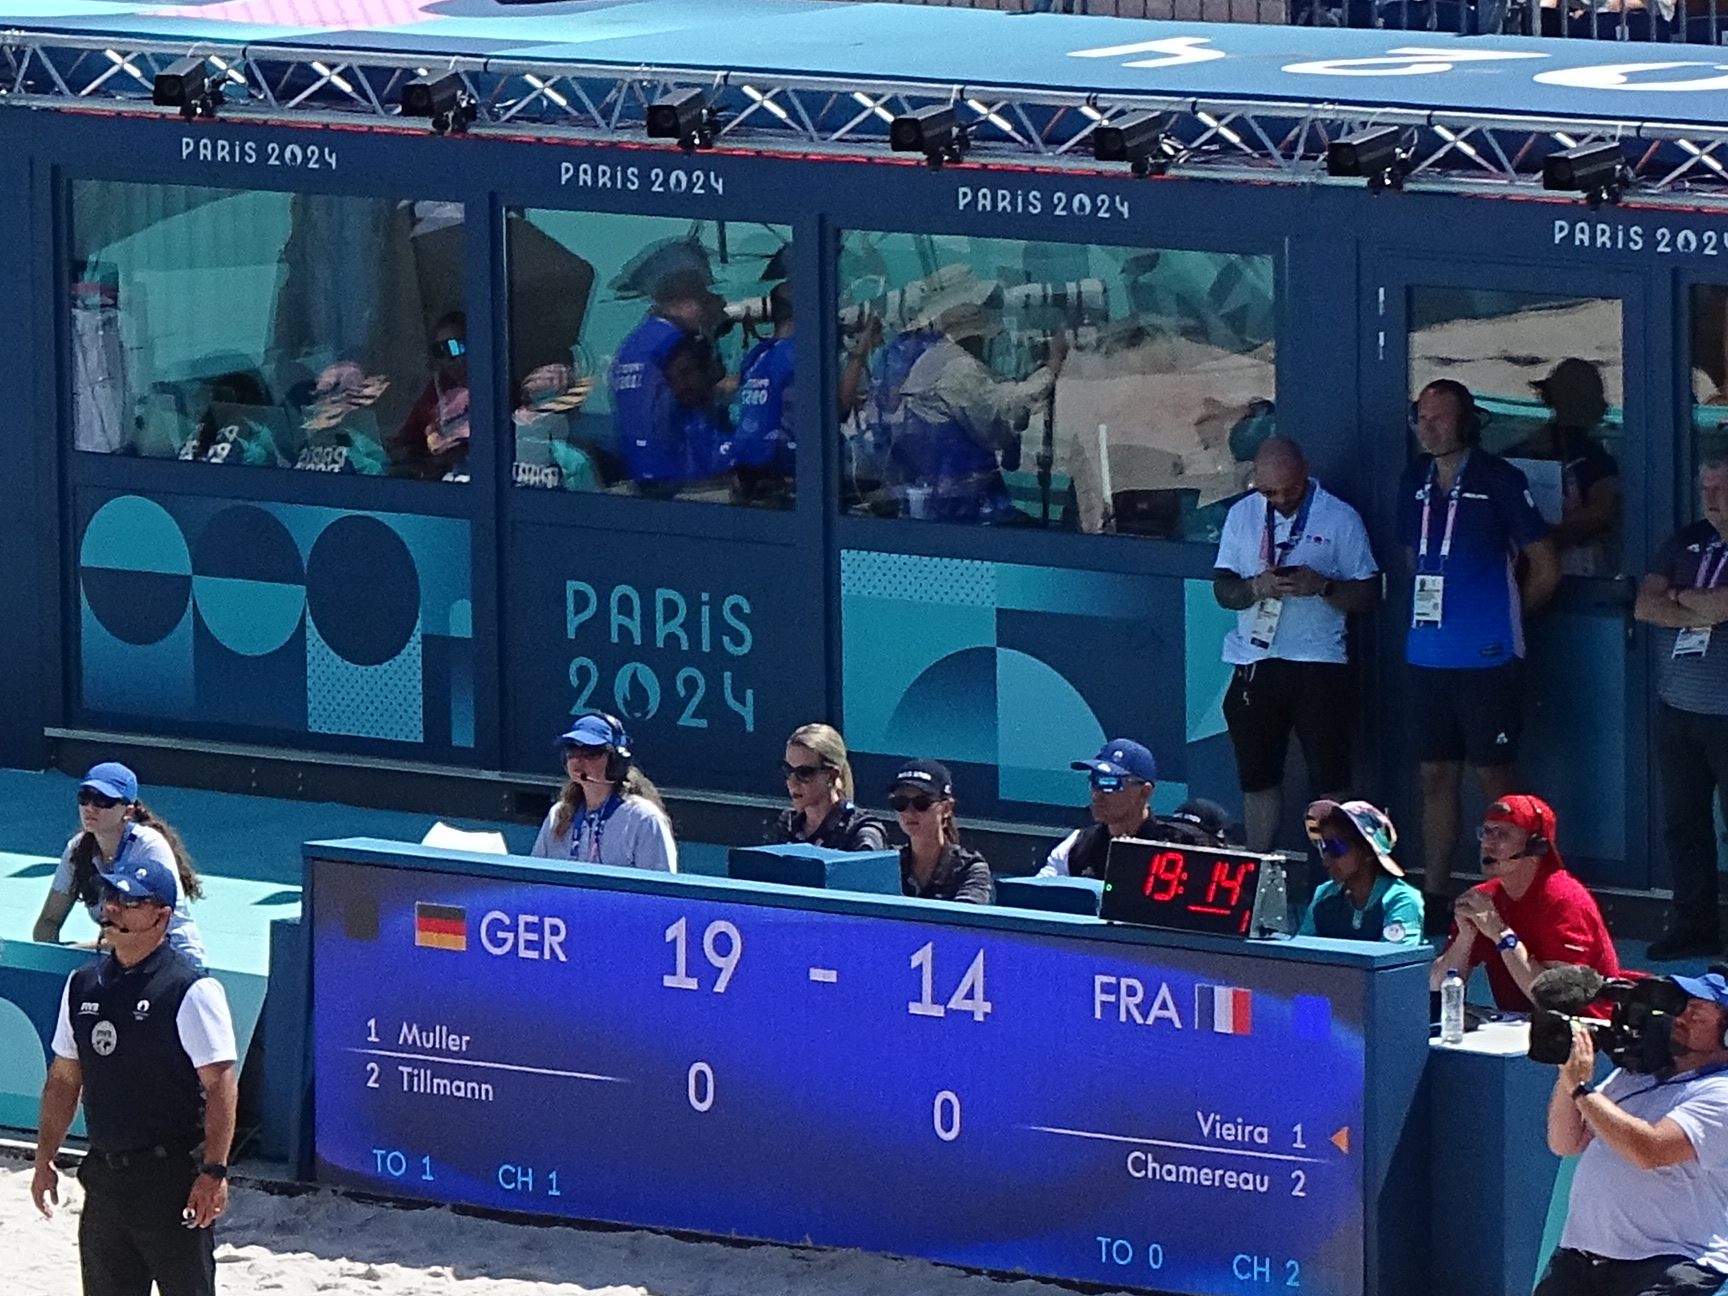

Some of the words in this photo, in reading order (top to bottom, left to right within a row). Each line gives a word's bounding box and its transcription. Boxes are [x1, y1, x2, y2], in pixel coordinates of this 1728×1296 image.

[182, 138, 256, 164] PARIS
[267, 143, 337, 169] 2024
[561, 162, 639, 190] PARIS
[651, 167, 723, 194] 2024
[958, 187, 1041, 214] PARIS
[1052, 192, 1129, 219] 2024
[1554, 220, 1644, 251] PARIS
[1656, 227, 1728, 256] 202
[566, 580, 753, 655] PARIS
[569, 657, 754, 731] 2024
[480, 912, 566, 963] GER
[661, 915, 743, 994] 19
[907, 943, 992, 1021] 14
[1092, 975, 1182, 1030] FRA
[366, 1018, 380, 1042] 1
[398, 1022, 471, 1052] Muller
[366, 1062, 380, 1087] 2
[398, 1065, 494, 1102] Tillmann
[688, 1061, 714, 1112] 0
[934, 1090, 961, 1141] 0
[1196, 1110, 1270, 1144] Vieira
[1291, 1124, 1306, 1149] 1
[372, 1149, 407, 1176] TO
[422, 1155, 435, 1181] 1
[498, 1164, 534, 1192] CH
[548, 1169, 561, 1196] 1
[1127, 1150, 1270, 1193] Chamereau
[1290, 1170, 1307, 1197] 2
[1096, 1236, 1133, 1265] TO
[1148, 1244, 1163, 1269] 0
[1232, 1253, 1271, 1284] CH
[1285, 1260, 1300, 1287] 2
